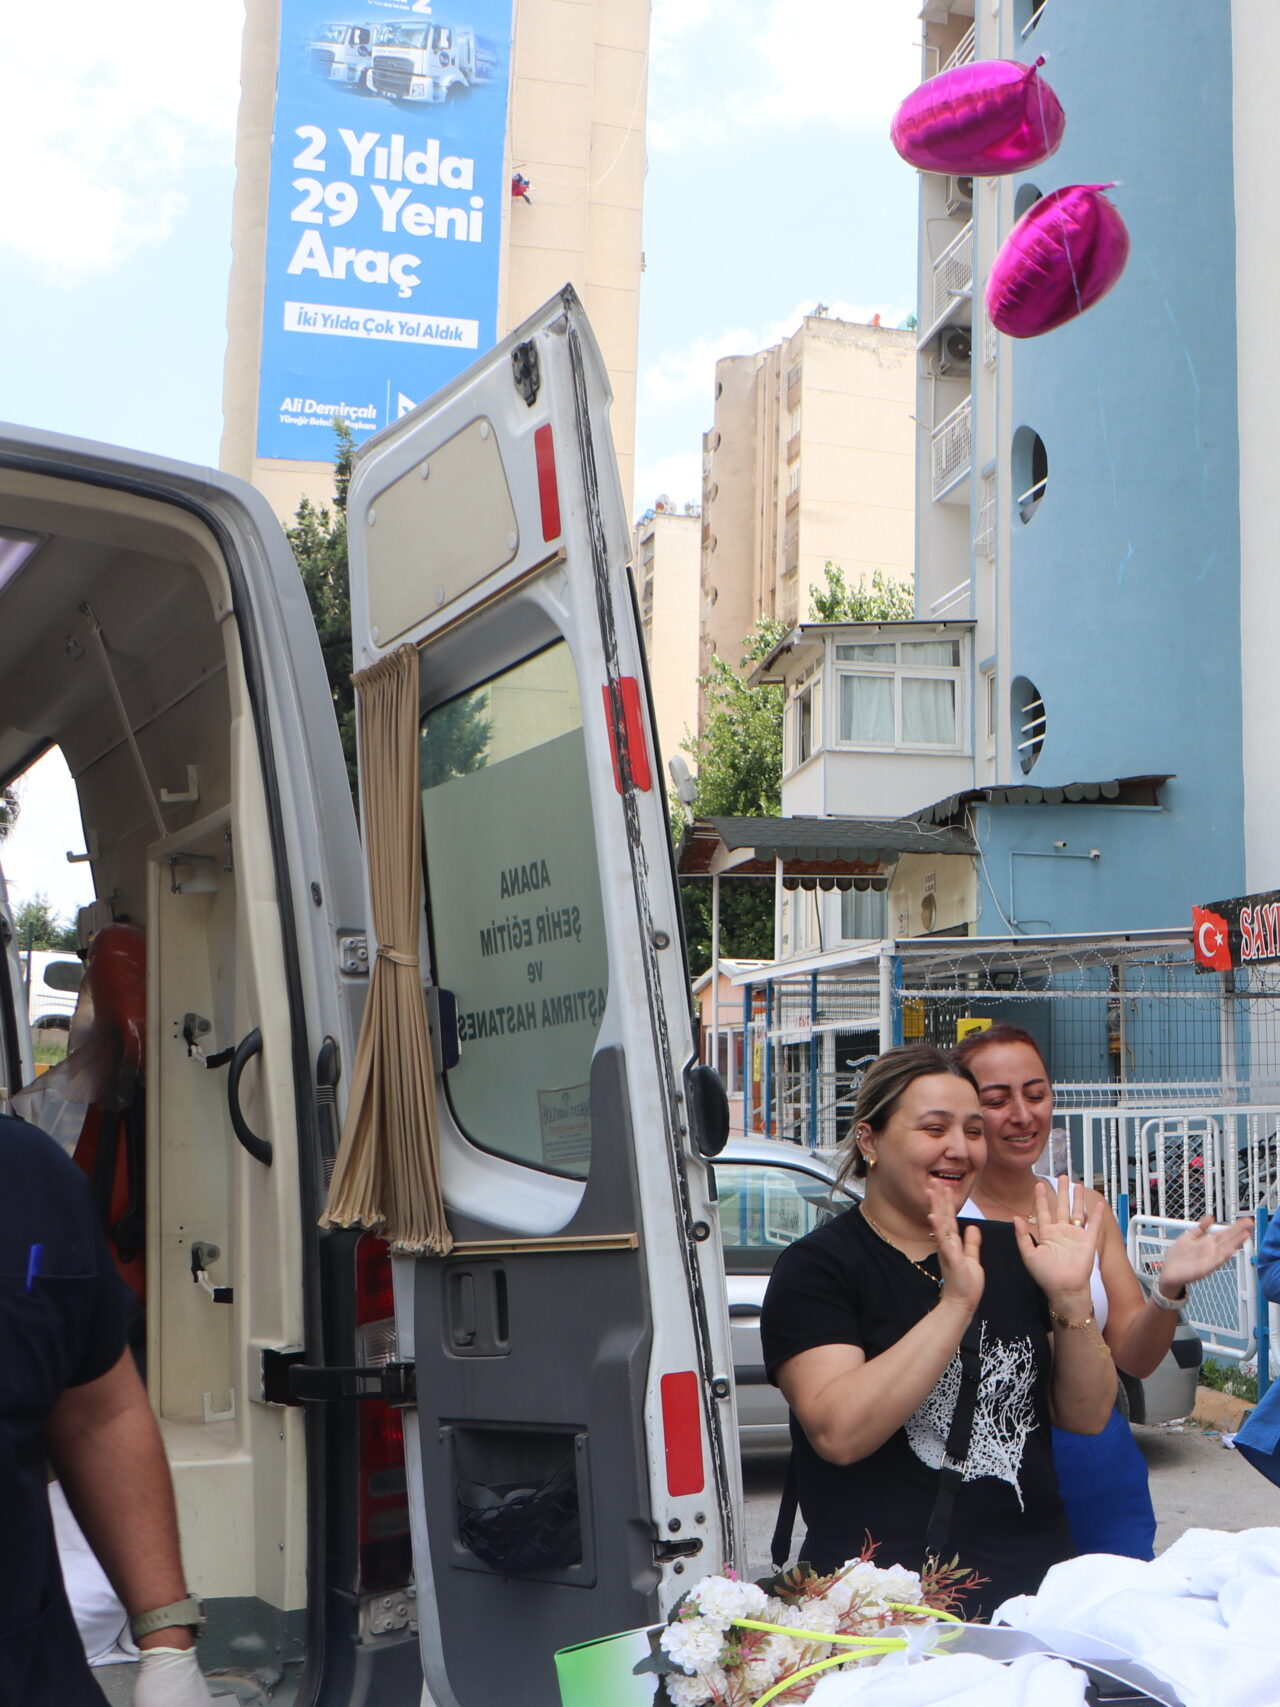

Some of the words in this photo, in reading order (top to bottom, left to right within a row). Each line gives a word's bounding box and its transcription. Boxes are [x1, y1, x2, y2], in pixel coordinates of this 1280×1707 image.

[293, 124, 327, 172] 2
[337, 127, 474, 191] Yılda
[290, 177, 359, 228] 29
[369, 184, 485, 243] Yeni
[286, 228, 422, 299] Araç
[297, 306, 318, 327] İki
[321, 312, 360, 332] Yılda
[363, 317, 394, 336] Çok
[398, 320, 420, 338] Yol
[422, 323, 463, 342] Aldık
[280, 397, 303, 412] Ali
[304, 399, 377, 420] Demirçalı
